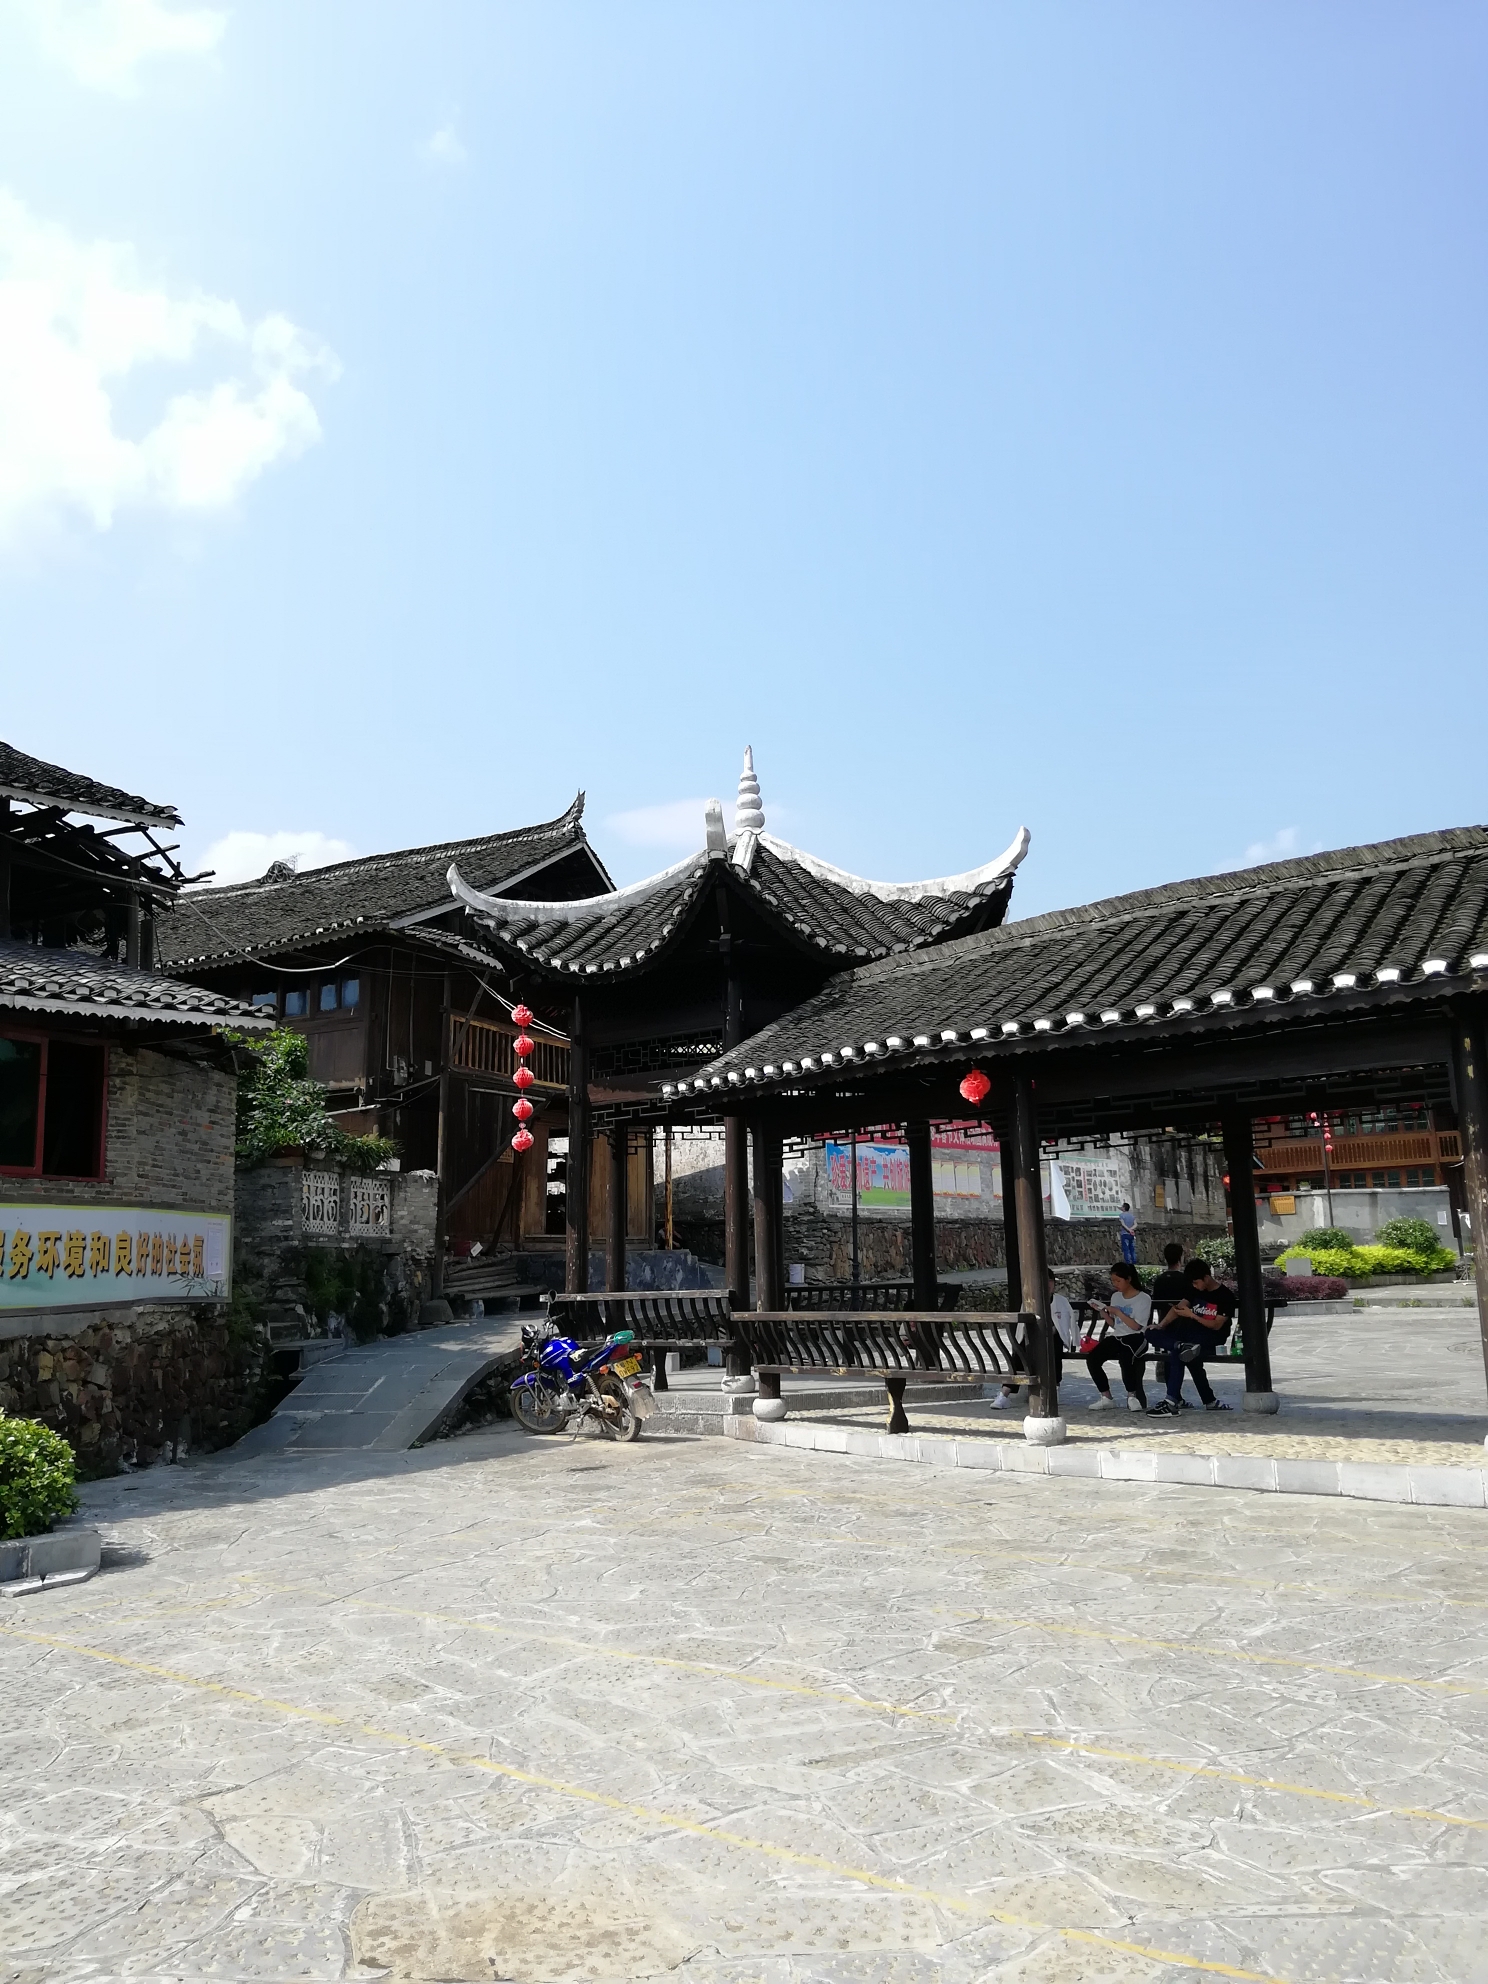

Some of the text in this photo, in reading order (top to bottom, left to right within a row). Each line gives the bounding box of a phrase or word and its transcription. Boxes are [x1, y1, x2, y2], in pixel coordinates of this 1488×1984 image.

[0, 1228, 204, 1279] 务环境和良好的社会氛
